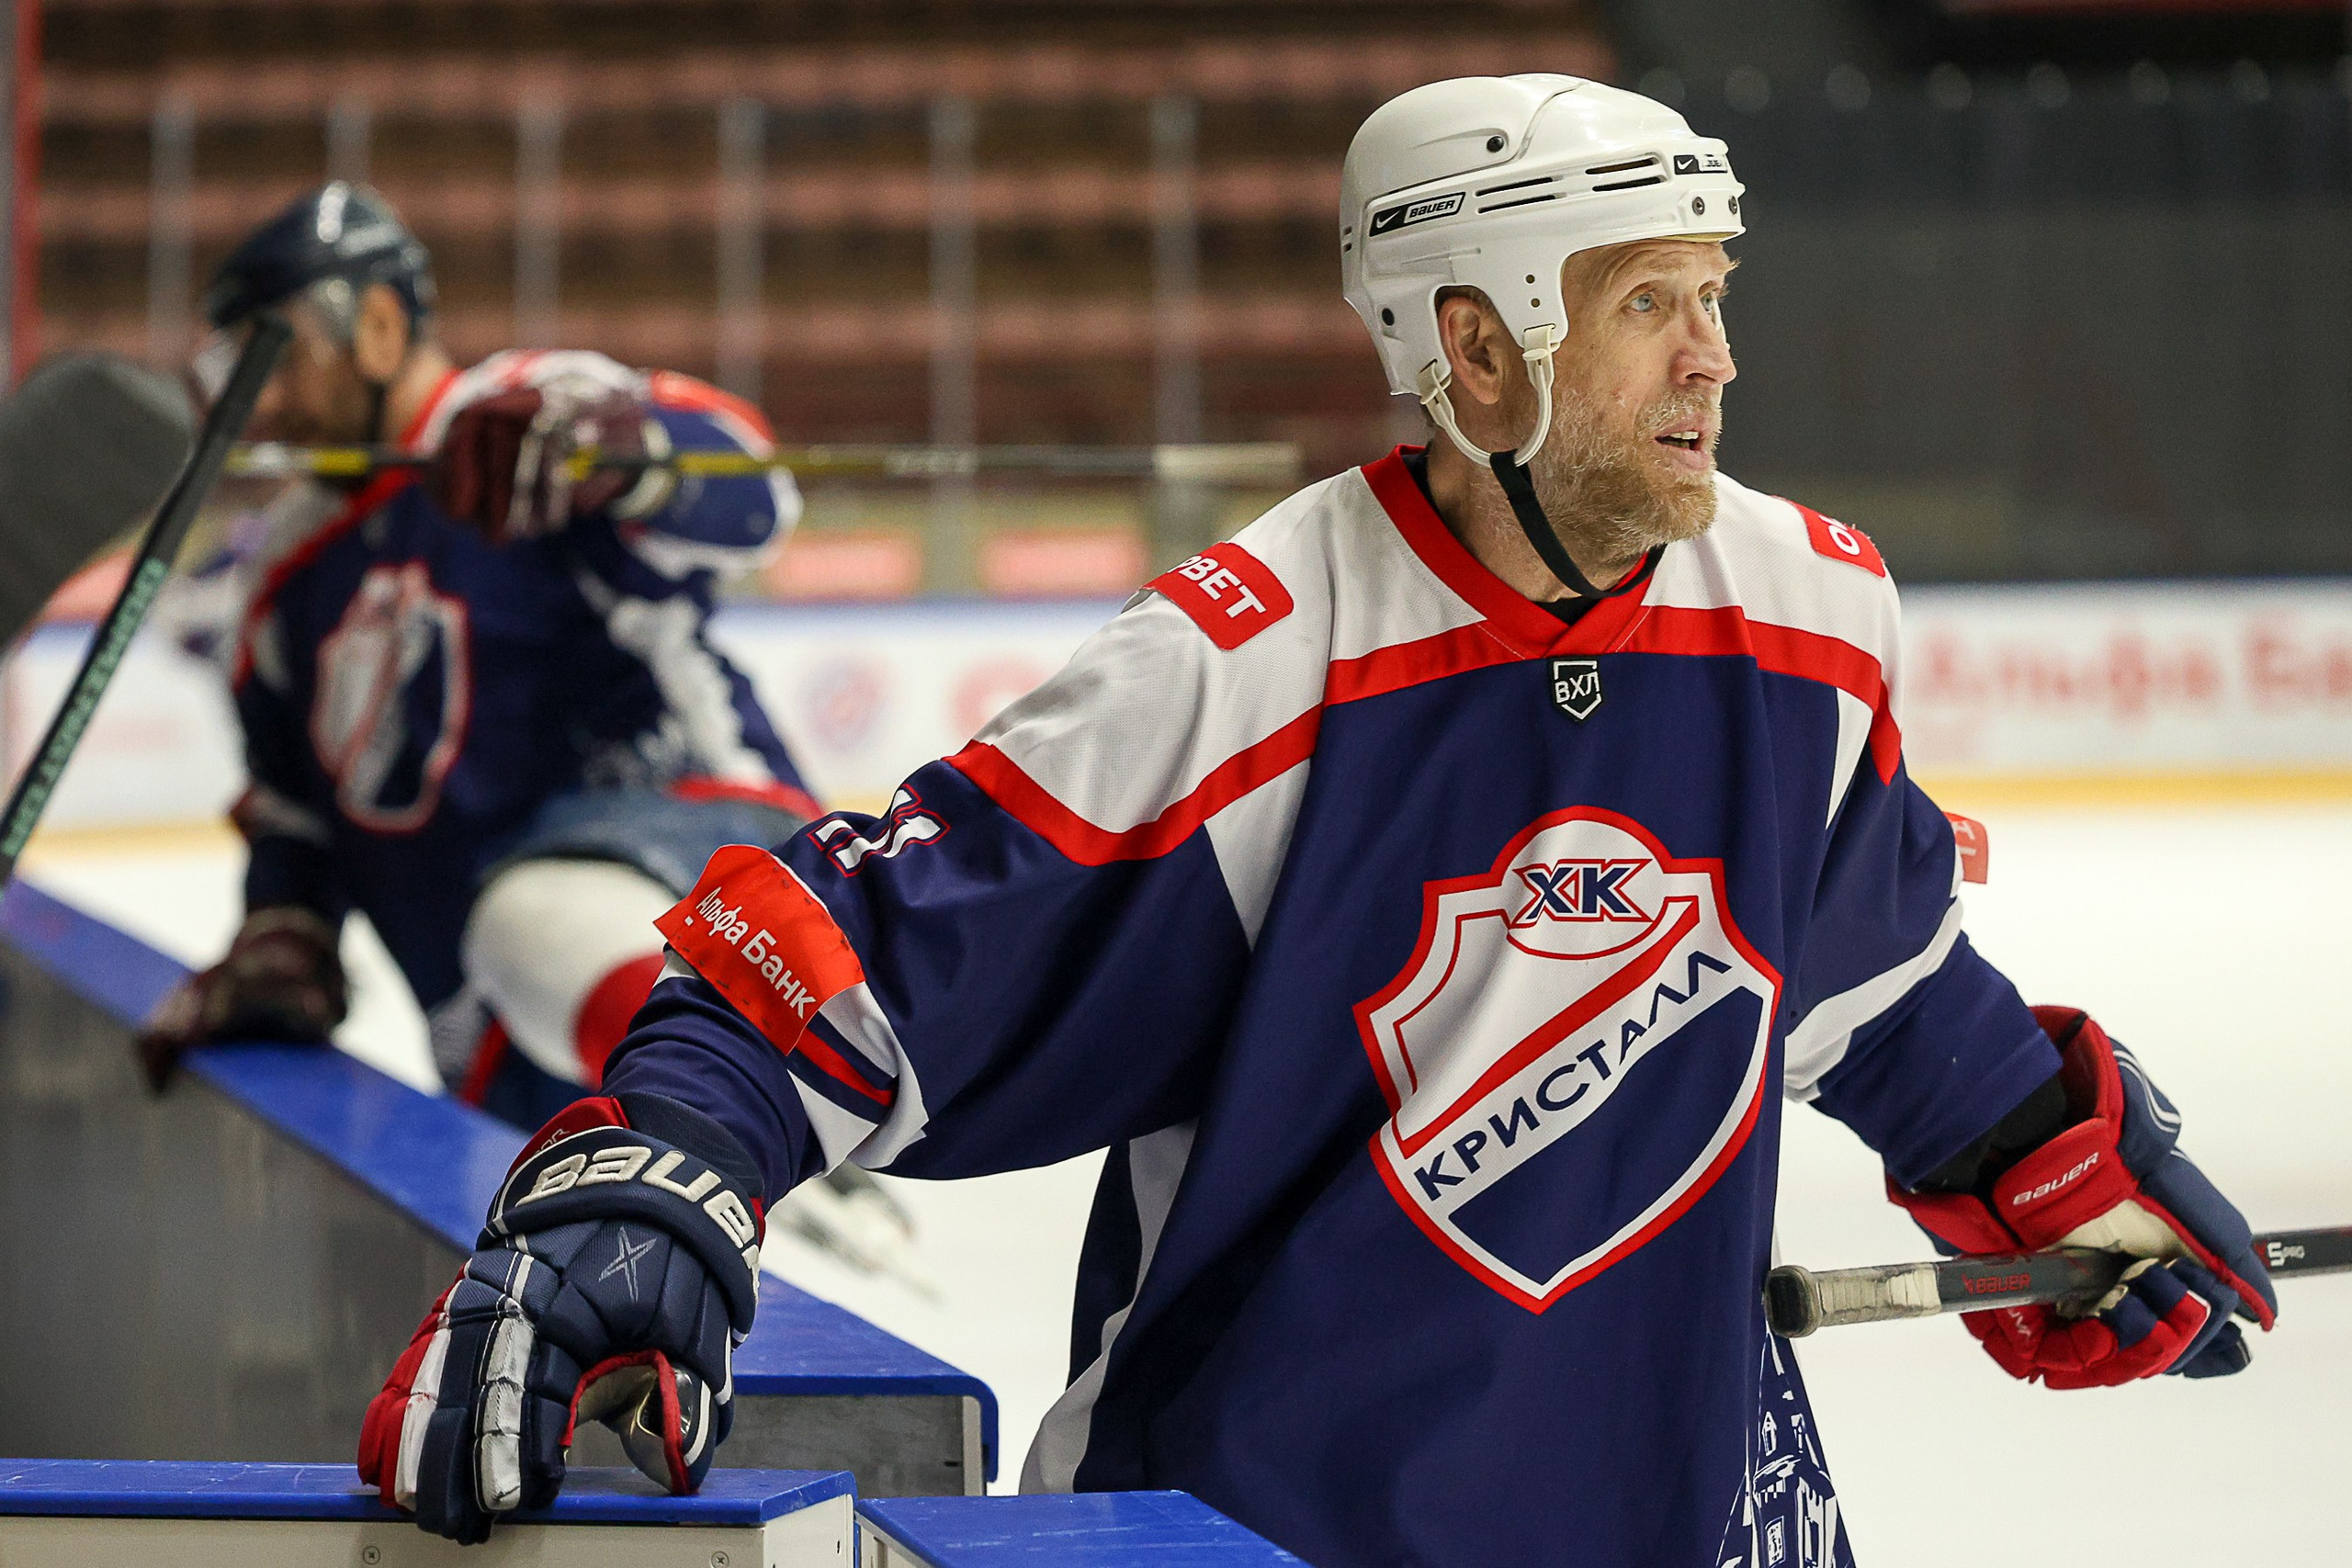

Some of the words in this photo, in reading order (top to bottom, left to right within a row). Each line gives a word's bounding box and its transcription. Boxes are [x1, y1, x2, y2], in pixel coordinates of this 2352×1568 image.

[1408, 199, 1455, 219] BAUER
[1555, 671, 1600, 704] ВХЛ
[1518, 862, 1646, 924] ХК
[695, 886, 750, 945] Альфа
[741, 928, 817, 1020] Банк
[1413, 950, 1733, 1201] КРИСТАЛЛ
[2012, 1151, 2099, 1206] BAUER
[1975, 1273, 2031, 1294] BAUER
